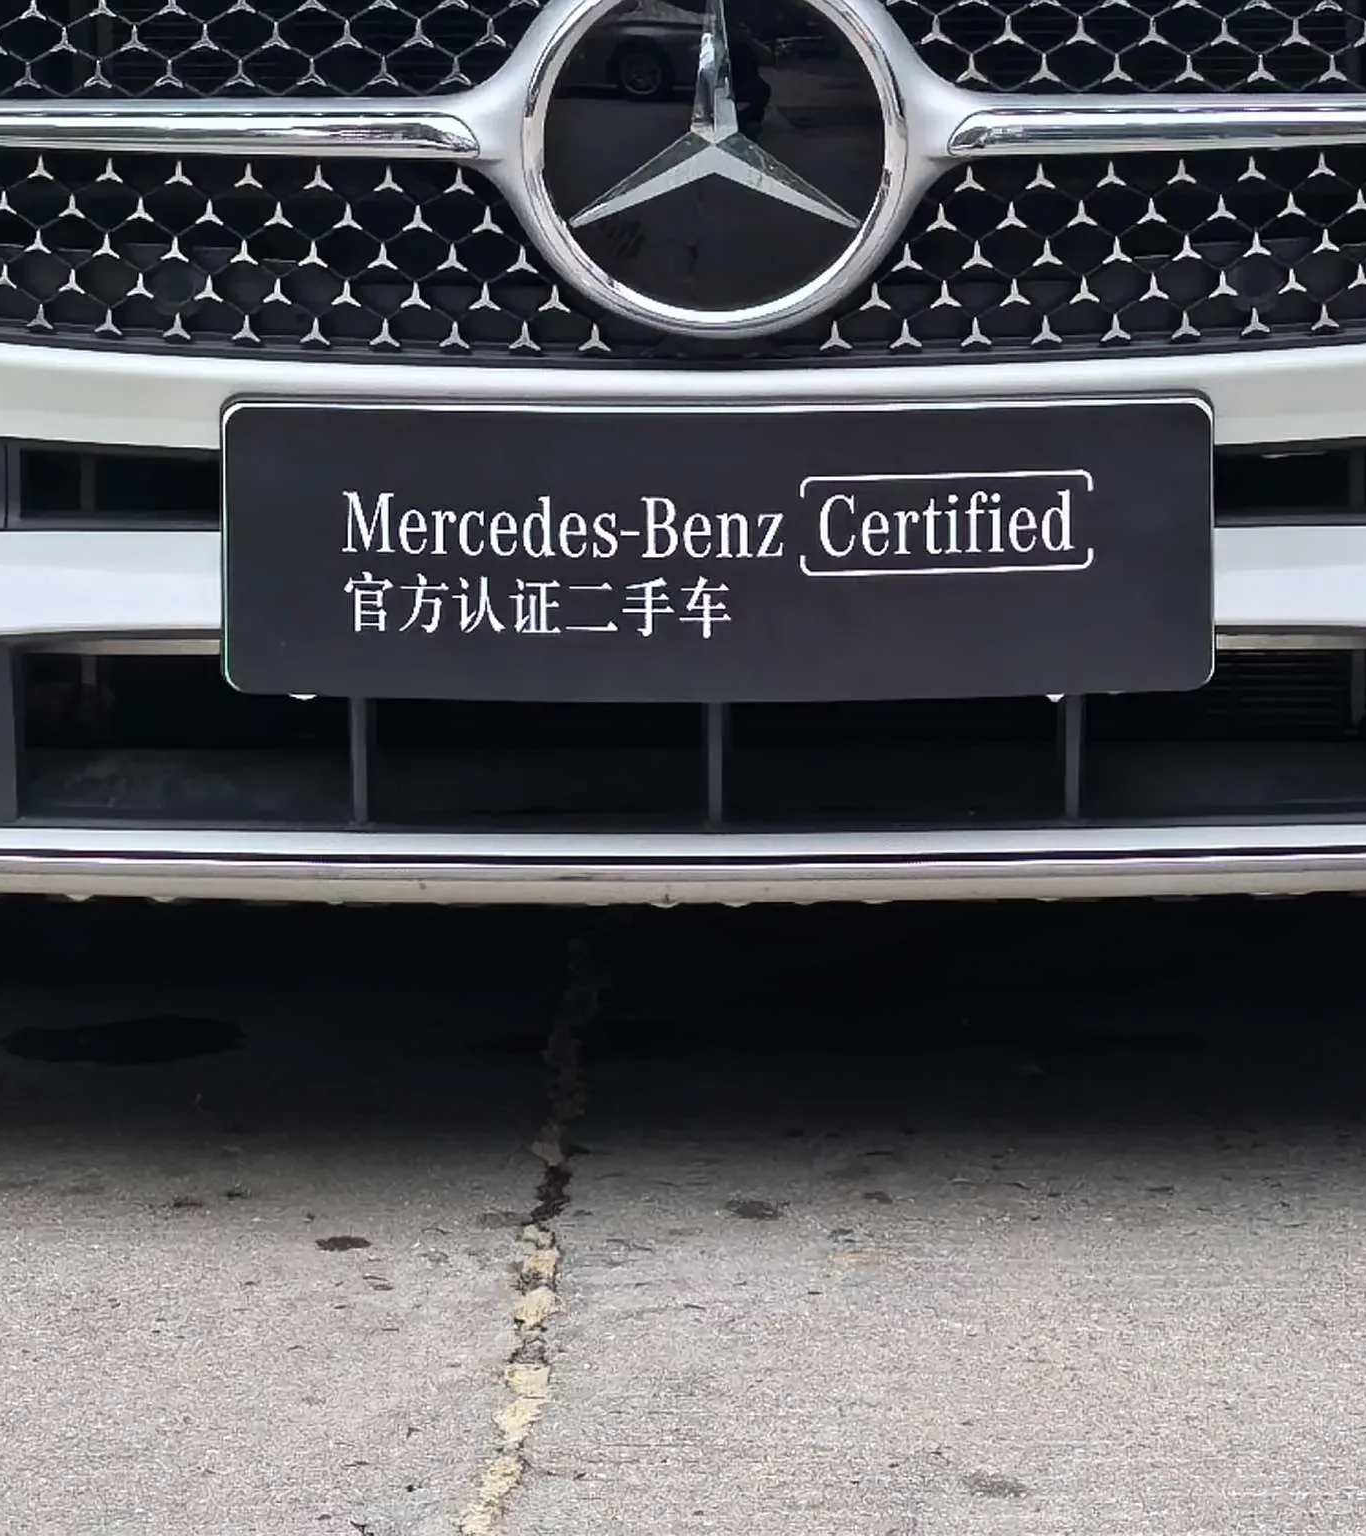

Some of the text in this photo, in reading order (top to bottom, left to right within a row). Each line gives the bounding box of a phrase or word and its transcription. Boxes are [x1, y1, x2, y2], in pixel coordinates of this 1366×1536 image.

[342, 490, 1076, 560] Mercedes-Benz Certified
[343, 572, 733, 640] 官方认证二手车
